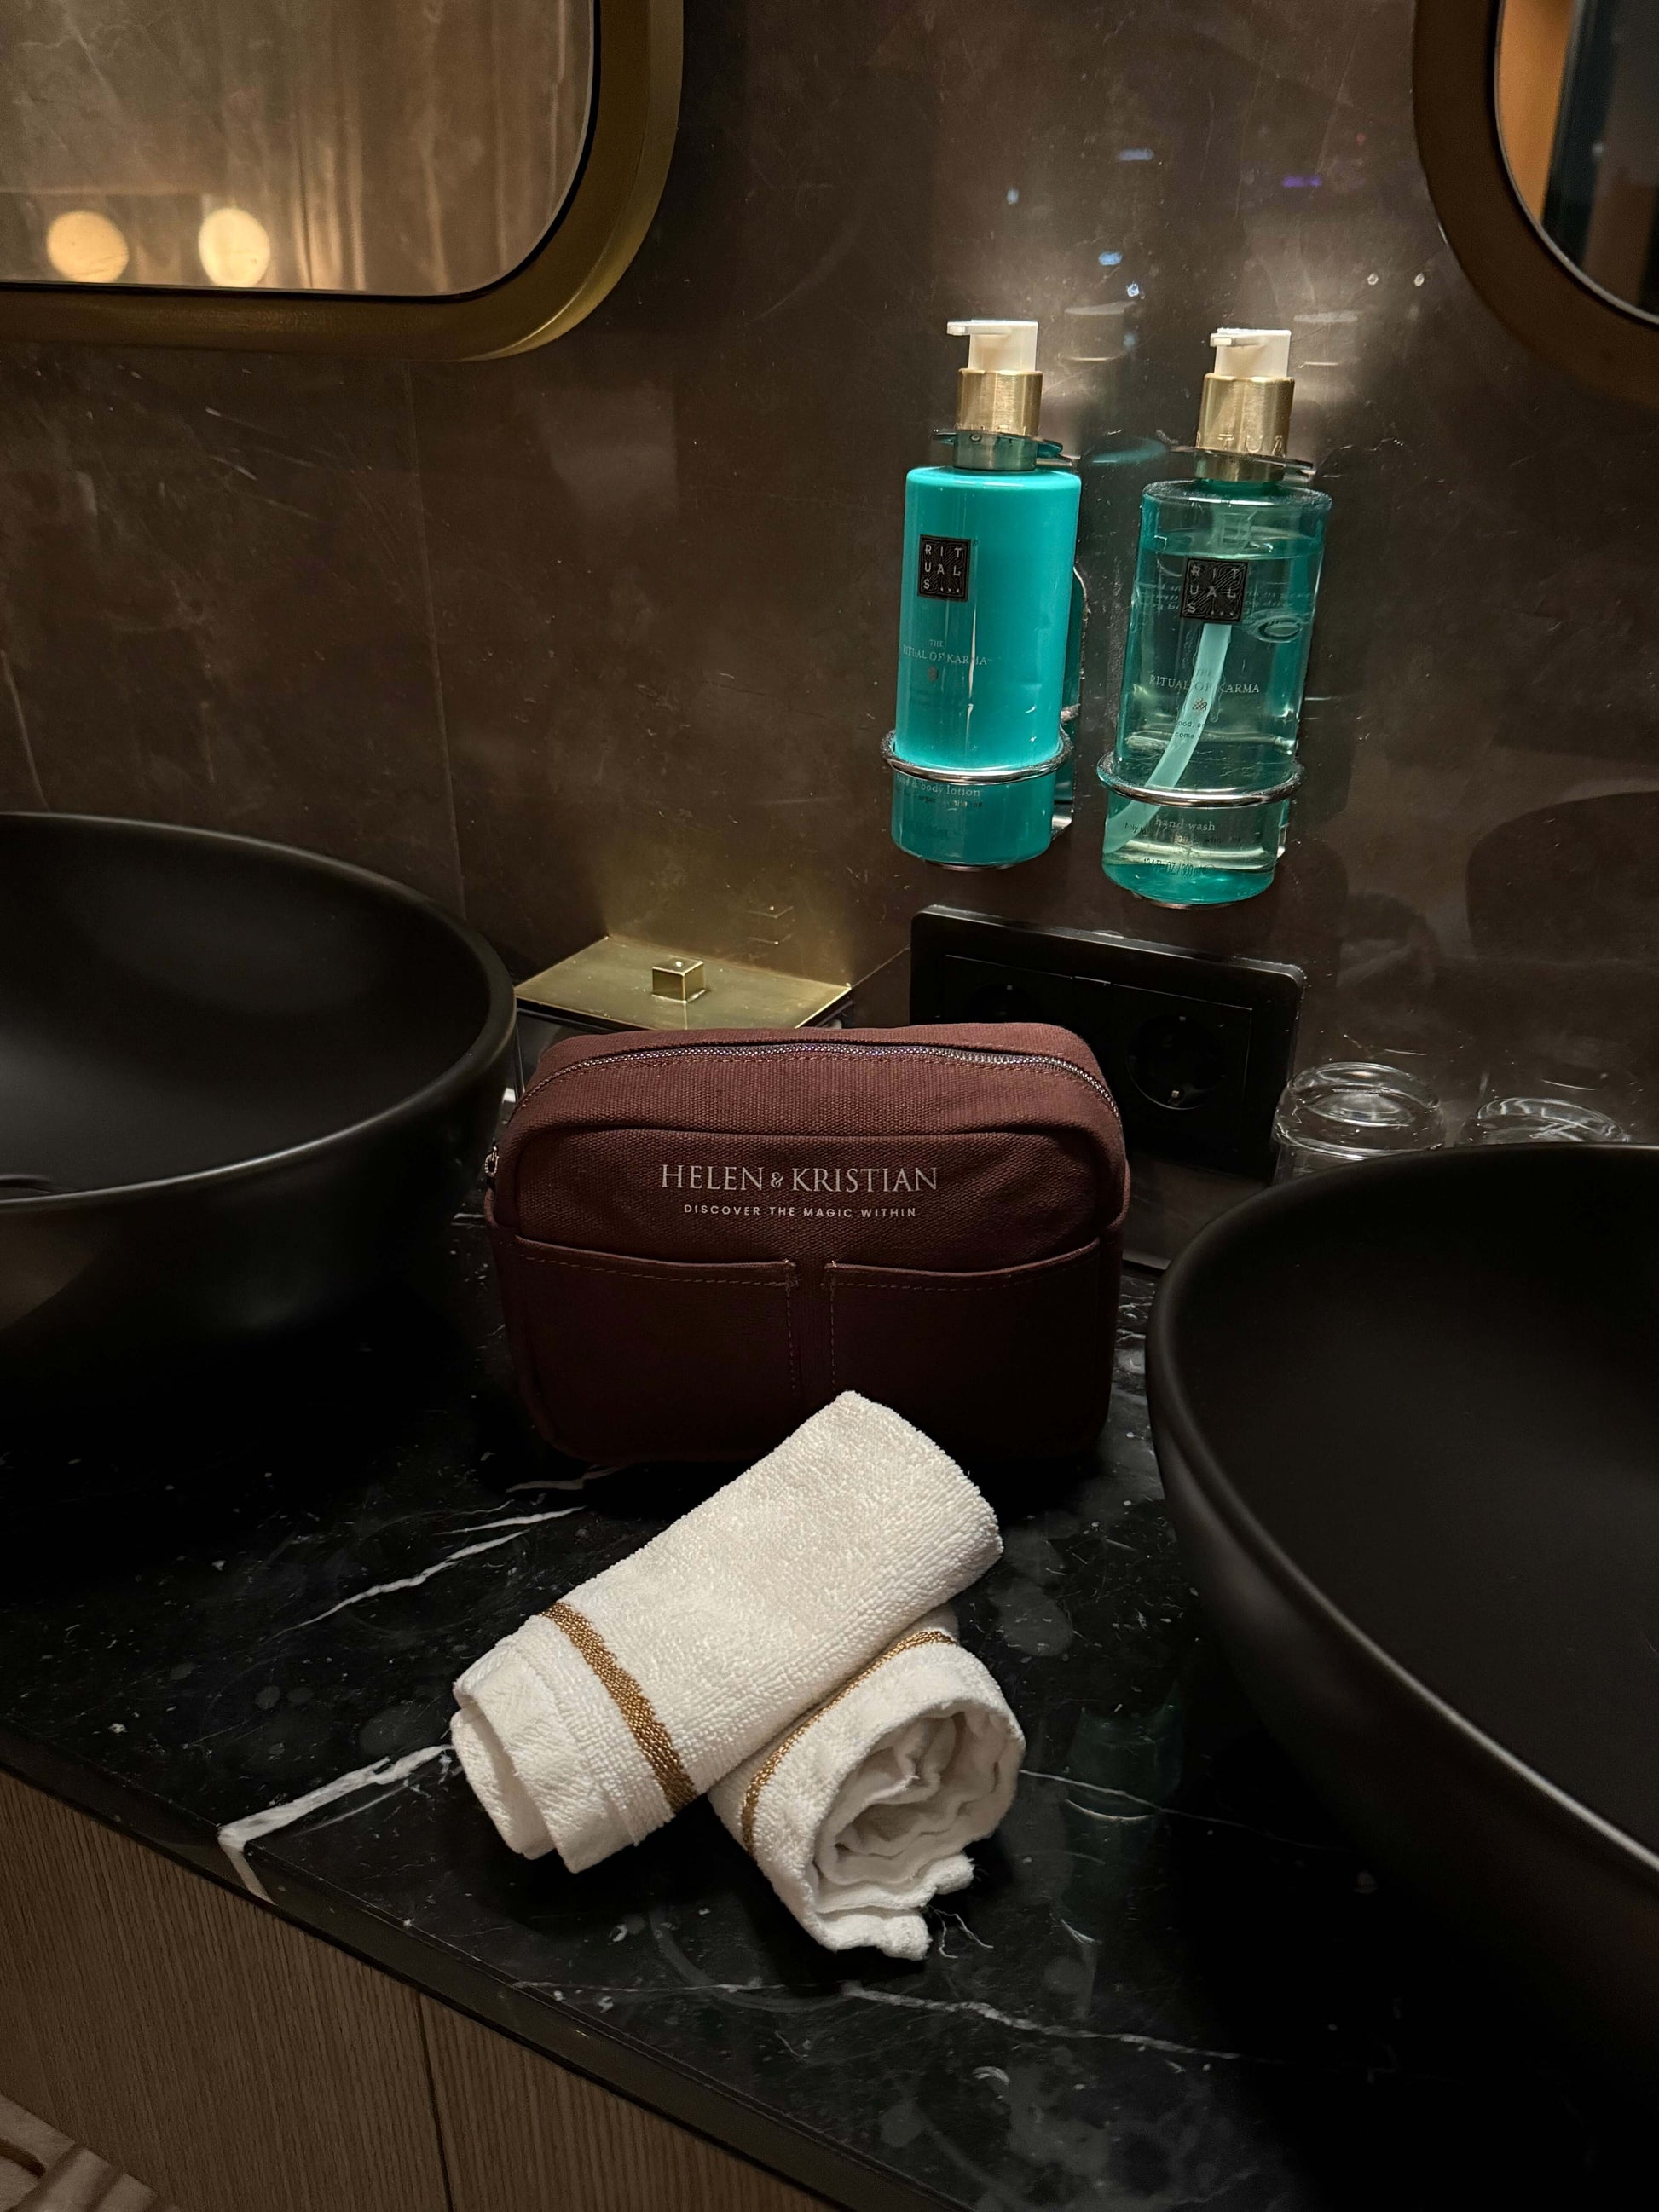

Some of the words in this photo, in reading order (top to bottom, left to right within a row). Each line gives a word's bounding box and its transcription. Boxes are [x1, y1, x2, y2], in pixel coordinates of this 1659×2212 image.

[924, 544, 962, 557] RIT
[923, 562, 961, 576] UAL
[1190, 564, 1239, 580] RIT
[1190, 584, 1236, 598] UAL
[921, 783, 944, 795] body
[946, 784, 980, 797] lotion
[1188, 821, 1215, 831] wash
[662, 1164, 764, 1191] HELEN
[770, 1171, 784, 1189] &
[792, 1167, 938, 1193] KRISTIAN
[684, 1204, 760, 1216] DISCOVER
[769, 1206, 795, 1217] THE
[803, 1207, 853, 1218] MAGIC
[860, 1207, 917, 1218] WITHIN
